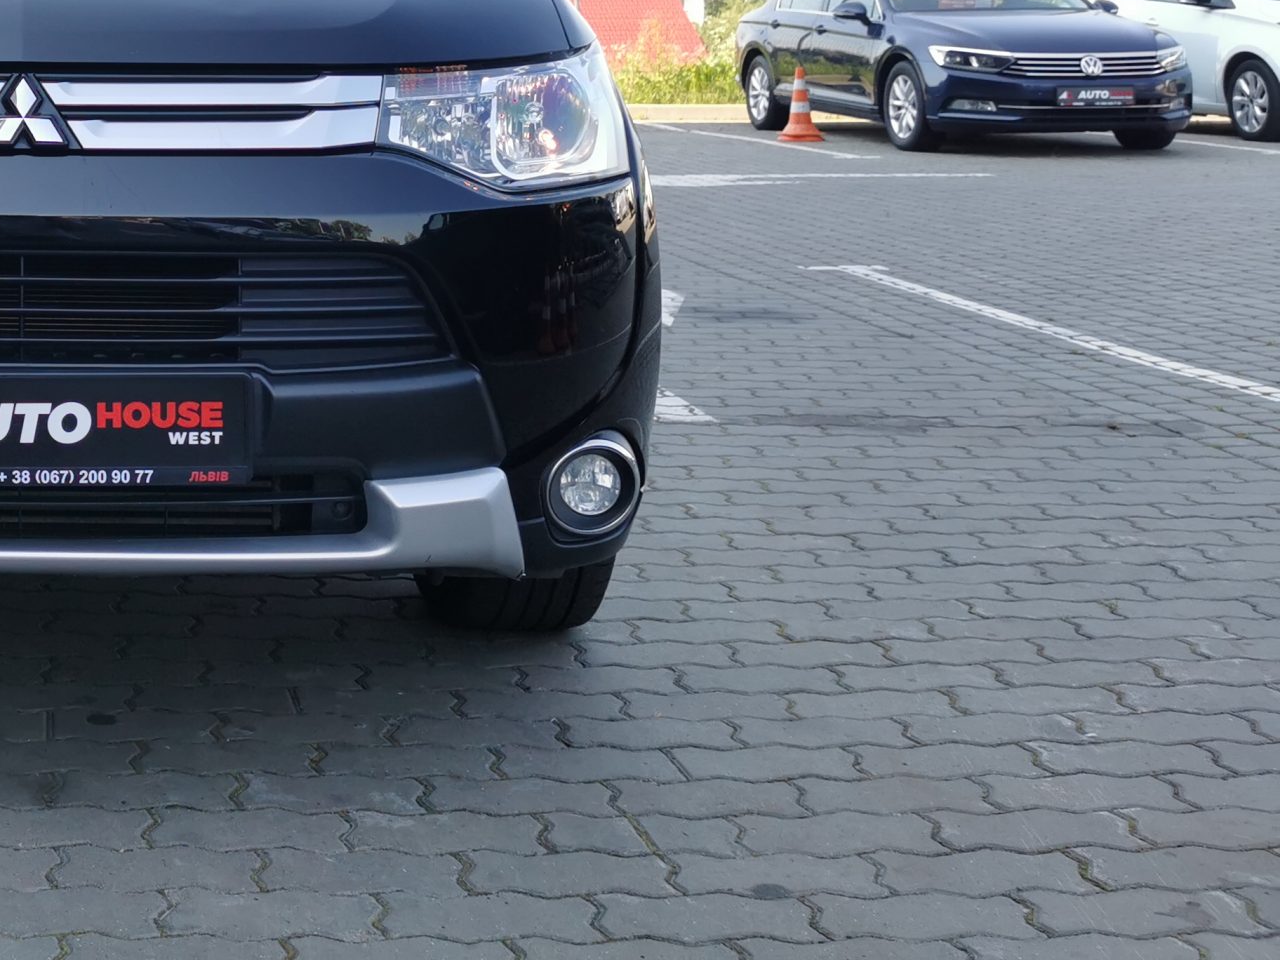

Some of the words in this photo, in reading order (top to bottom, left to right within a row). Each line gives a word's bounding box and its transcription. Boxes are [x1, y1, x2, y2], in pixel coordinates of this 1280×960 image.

[1077, 89, 1110, 99] AUTO
[96, 401, 224, 429] HOUSE
[168, 431, 224, 445] WEST
[12, 470, 31, 484] 38
[35, 470, 74, 485] (067)
[79, 470, 107, 484] 200
[111, 470, 131, 484] 90
[135, 470, 154, 484] 77
[188, 471, 229, 483] ЛЬВІВ
